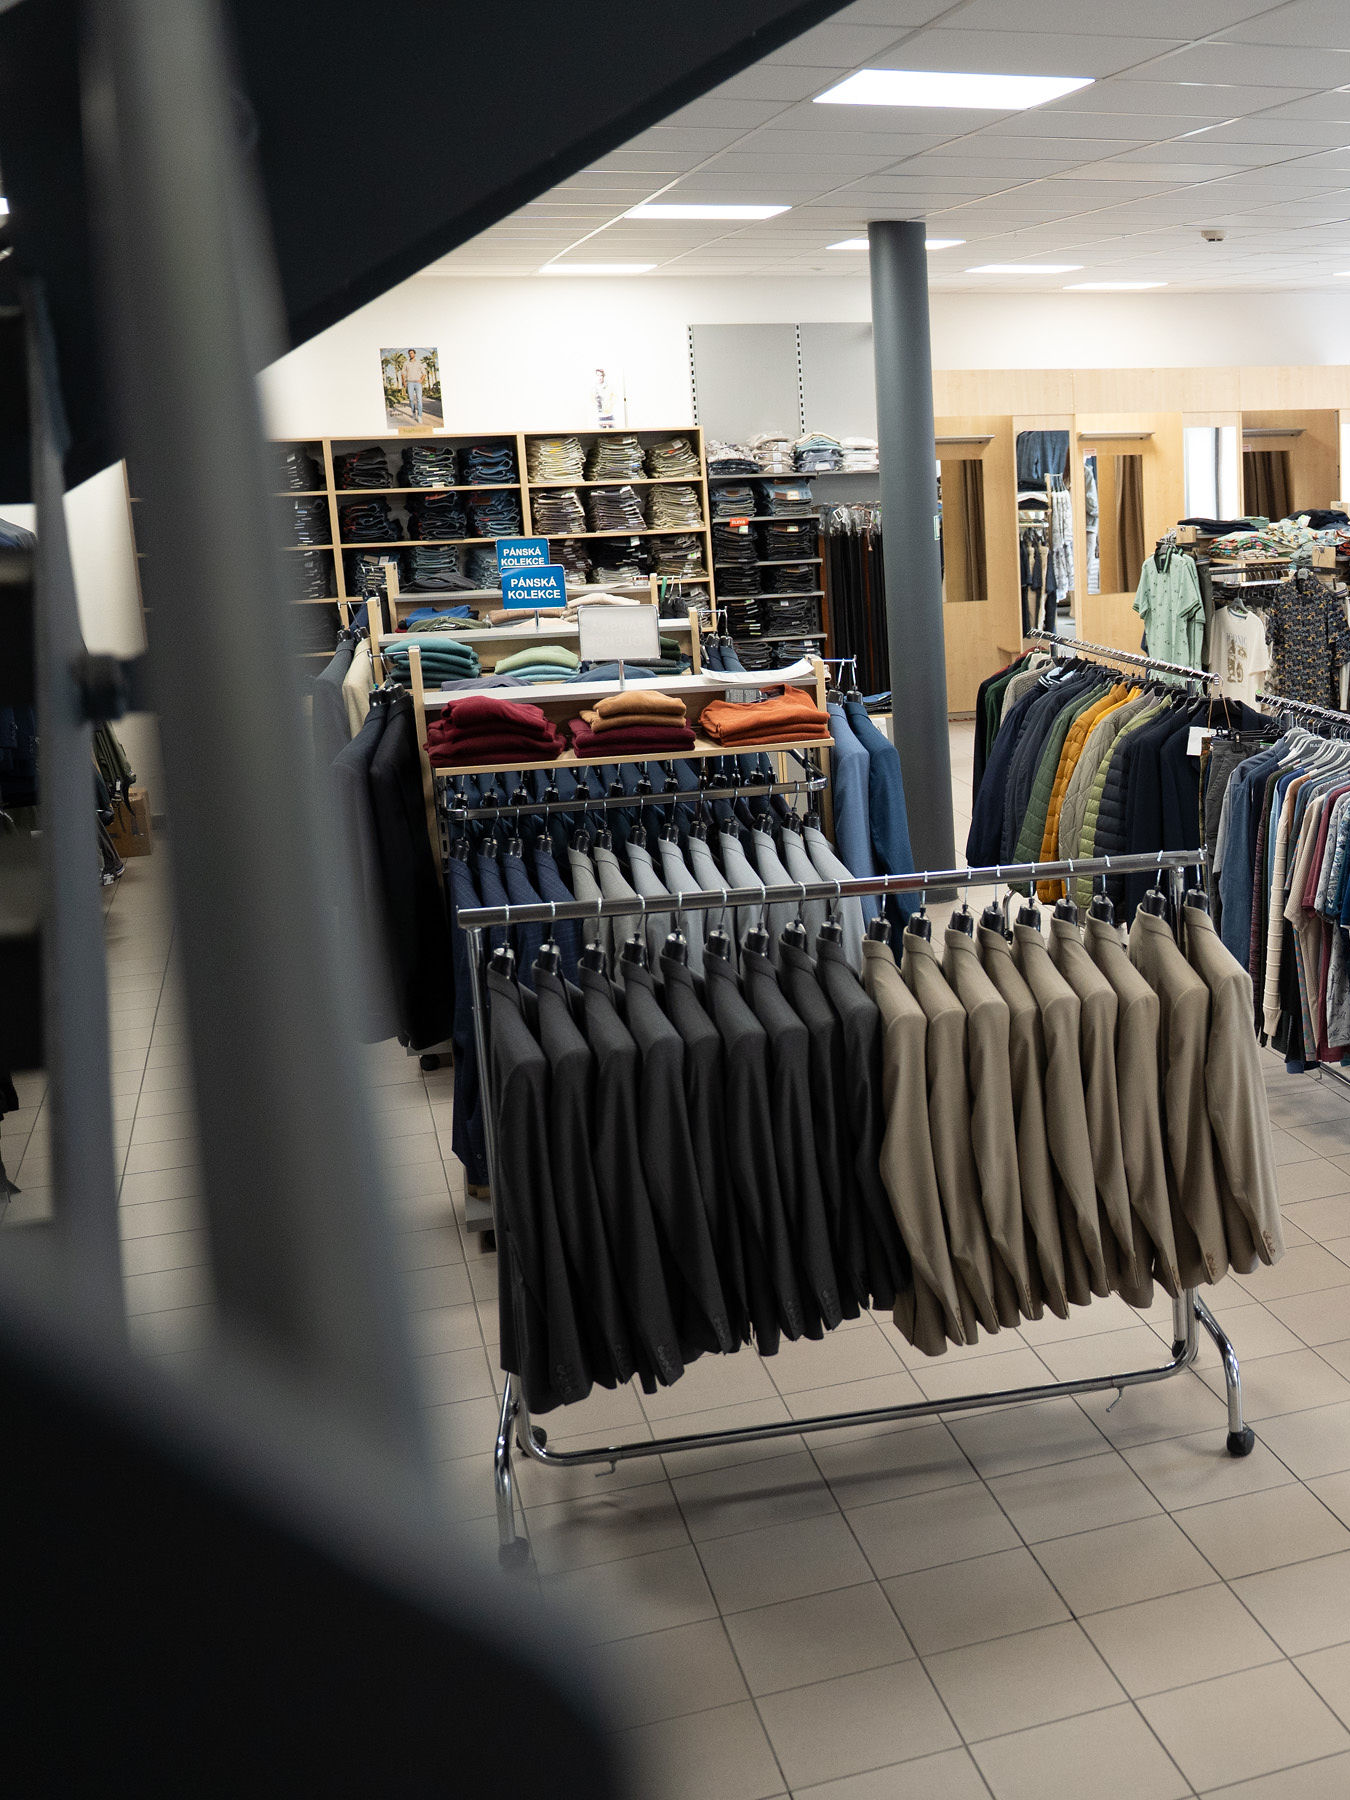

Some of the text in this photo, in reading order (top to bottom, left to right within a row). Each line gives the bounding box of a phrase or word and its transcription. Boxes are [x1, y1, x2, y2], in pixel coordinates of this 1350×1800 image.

[503, 546, 542, 557] PÁNSKÁ
[501, 557, 545, 566] KOLEKCE
[510, 576, 557, 588] PÁNSKÁ
[508, 589, 561, 600] KOLEKCE
